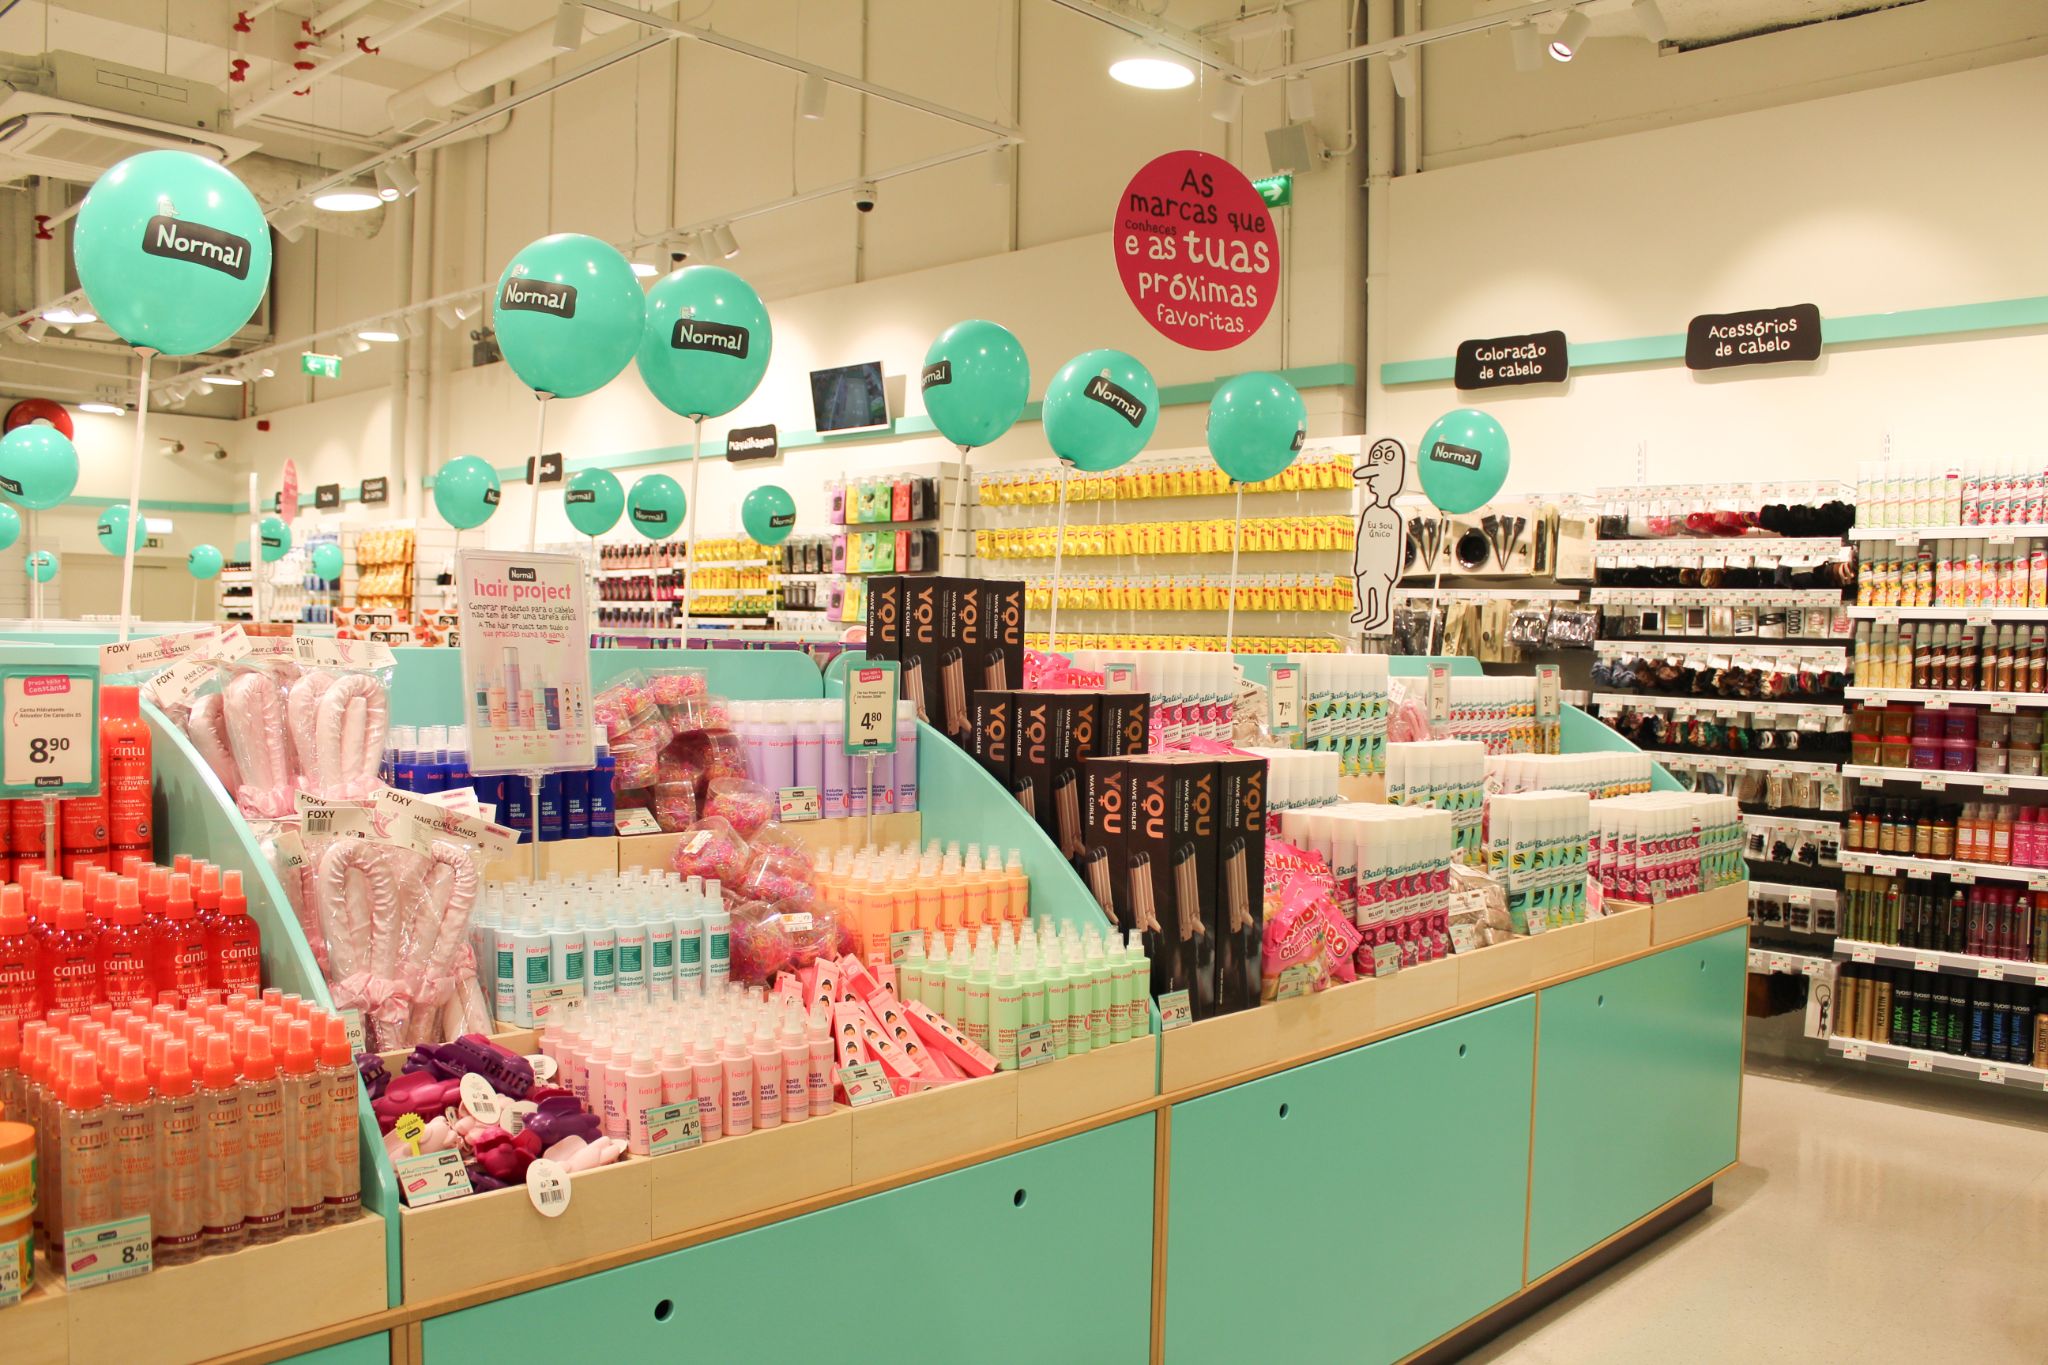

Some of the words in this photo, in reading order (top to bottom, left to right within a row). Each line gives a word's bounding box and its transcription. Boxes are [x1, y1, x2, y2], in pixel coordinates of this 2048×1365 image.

[1180, 168, 1214, 198] As
[1130, 193, 1218, 224] marcas
[1228, 212, 1266, 232] que
[1125, 219, 1177, 236] conheces
[156, 223, 243, 269] Normal
[1125, 235, 1139, 255] e
[1148, 235, 1177, 260] as
[1183, 230, 1270, 274] tuas
[505, 282, 567, 310] Normal
[1138, 272, 1258, 307] próximas
[680, 324, 743, 351] Normal
[1707, 317, 1798, 340] Acessórios
[1475, 342, 1547, 364] Coloração
[1714, 342, 1733, 357] de
[1738, 337, 1791, 355] cabelo
[1479, 366, 1494, 380] de
[1498, 363, 1543, 378] cabelo
[1092, 381, 1142, 421] Normal
[1435, 446, 1477, 466] Normal
[634, 509, 664, 522] Normal
[1368, 521, 1377, 529] Eu
[1379, 522, 1393, 530] sou
[1369, 529, 1391, 538] único
[511, 569, 534, 579] Normal
[474, 578, 508, 597] hair
[513, 581, 571, 603] project
[469, 602, 498, 612] Comprar
[500, 604, 530, 613] produtos
[877, 586, 896, 642] YOU
[913, 586, 933, 643] YOU
[959, 588, 978, 644] YOU
[1000, 591, 1020, 645] YOU
[106, 643, 131, 654] FOXY
[296, 637, 315, 646] FOXY
[136, 652, 153, 660] HAIR
[155, 670, 175, 687] FOXY
[183, 668, 197, 681] HAIR
[860, 712, 882, 731] 4,80
[985, 702, 1006, 762] YOU
[1025, 704, 1046, 764] YOU
[1073, 704, 1093, 763] YOU
[30, 737, 70, 764] 8,90
[37, 777, 61, 785] Normal
[300, 794, 327, 807] FOXY
[385, 791, 413, 807] FOXY
[1098, 771, 1121, 833] YOU
[1141, 775, 1164, 839] YOU
[1192, 773, 1211, 836] YOU
[1241, 770, 1262, 831] YOU
[307, 810, 335, 819] FOXY
[413, 814, 431, 825] HAIR
[433, 819, 452, 829] CURL
[453, 825, 478, 838] BANDS
[175, 951, 208, 964] cantu
[221, 946, 258, 959] cantu
[53, 963, 97, 977] cantu
[104, 959, 144, 971] cantu
[0, 970, 36, 983] antu
[1878, 997, 1888, 1028] KERATIN
[1894, 1006, 1903, 1030] MAX
[1912, 1008, 1921, 1033] MAX
[1972, 1009, 1983, 1041] VOLUME
[1992, 1011, 2003, 1044] VOLUME
[2011, 1014, 2021, 1047] VOLUME
[342, 1195, 358, 1203] STYLE
[223, 1223, 241, 1232] STYLE
[262, 1214, 280, 1223] STYLE
[178, 1234, 199, 1243] STYLE
